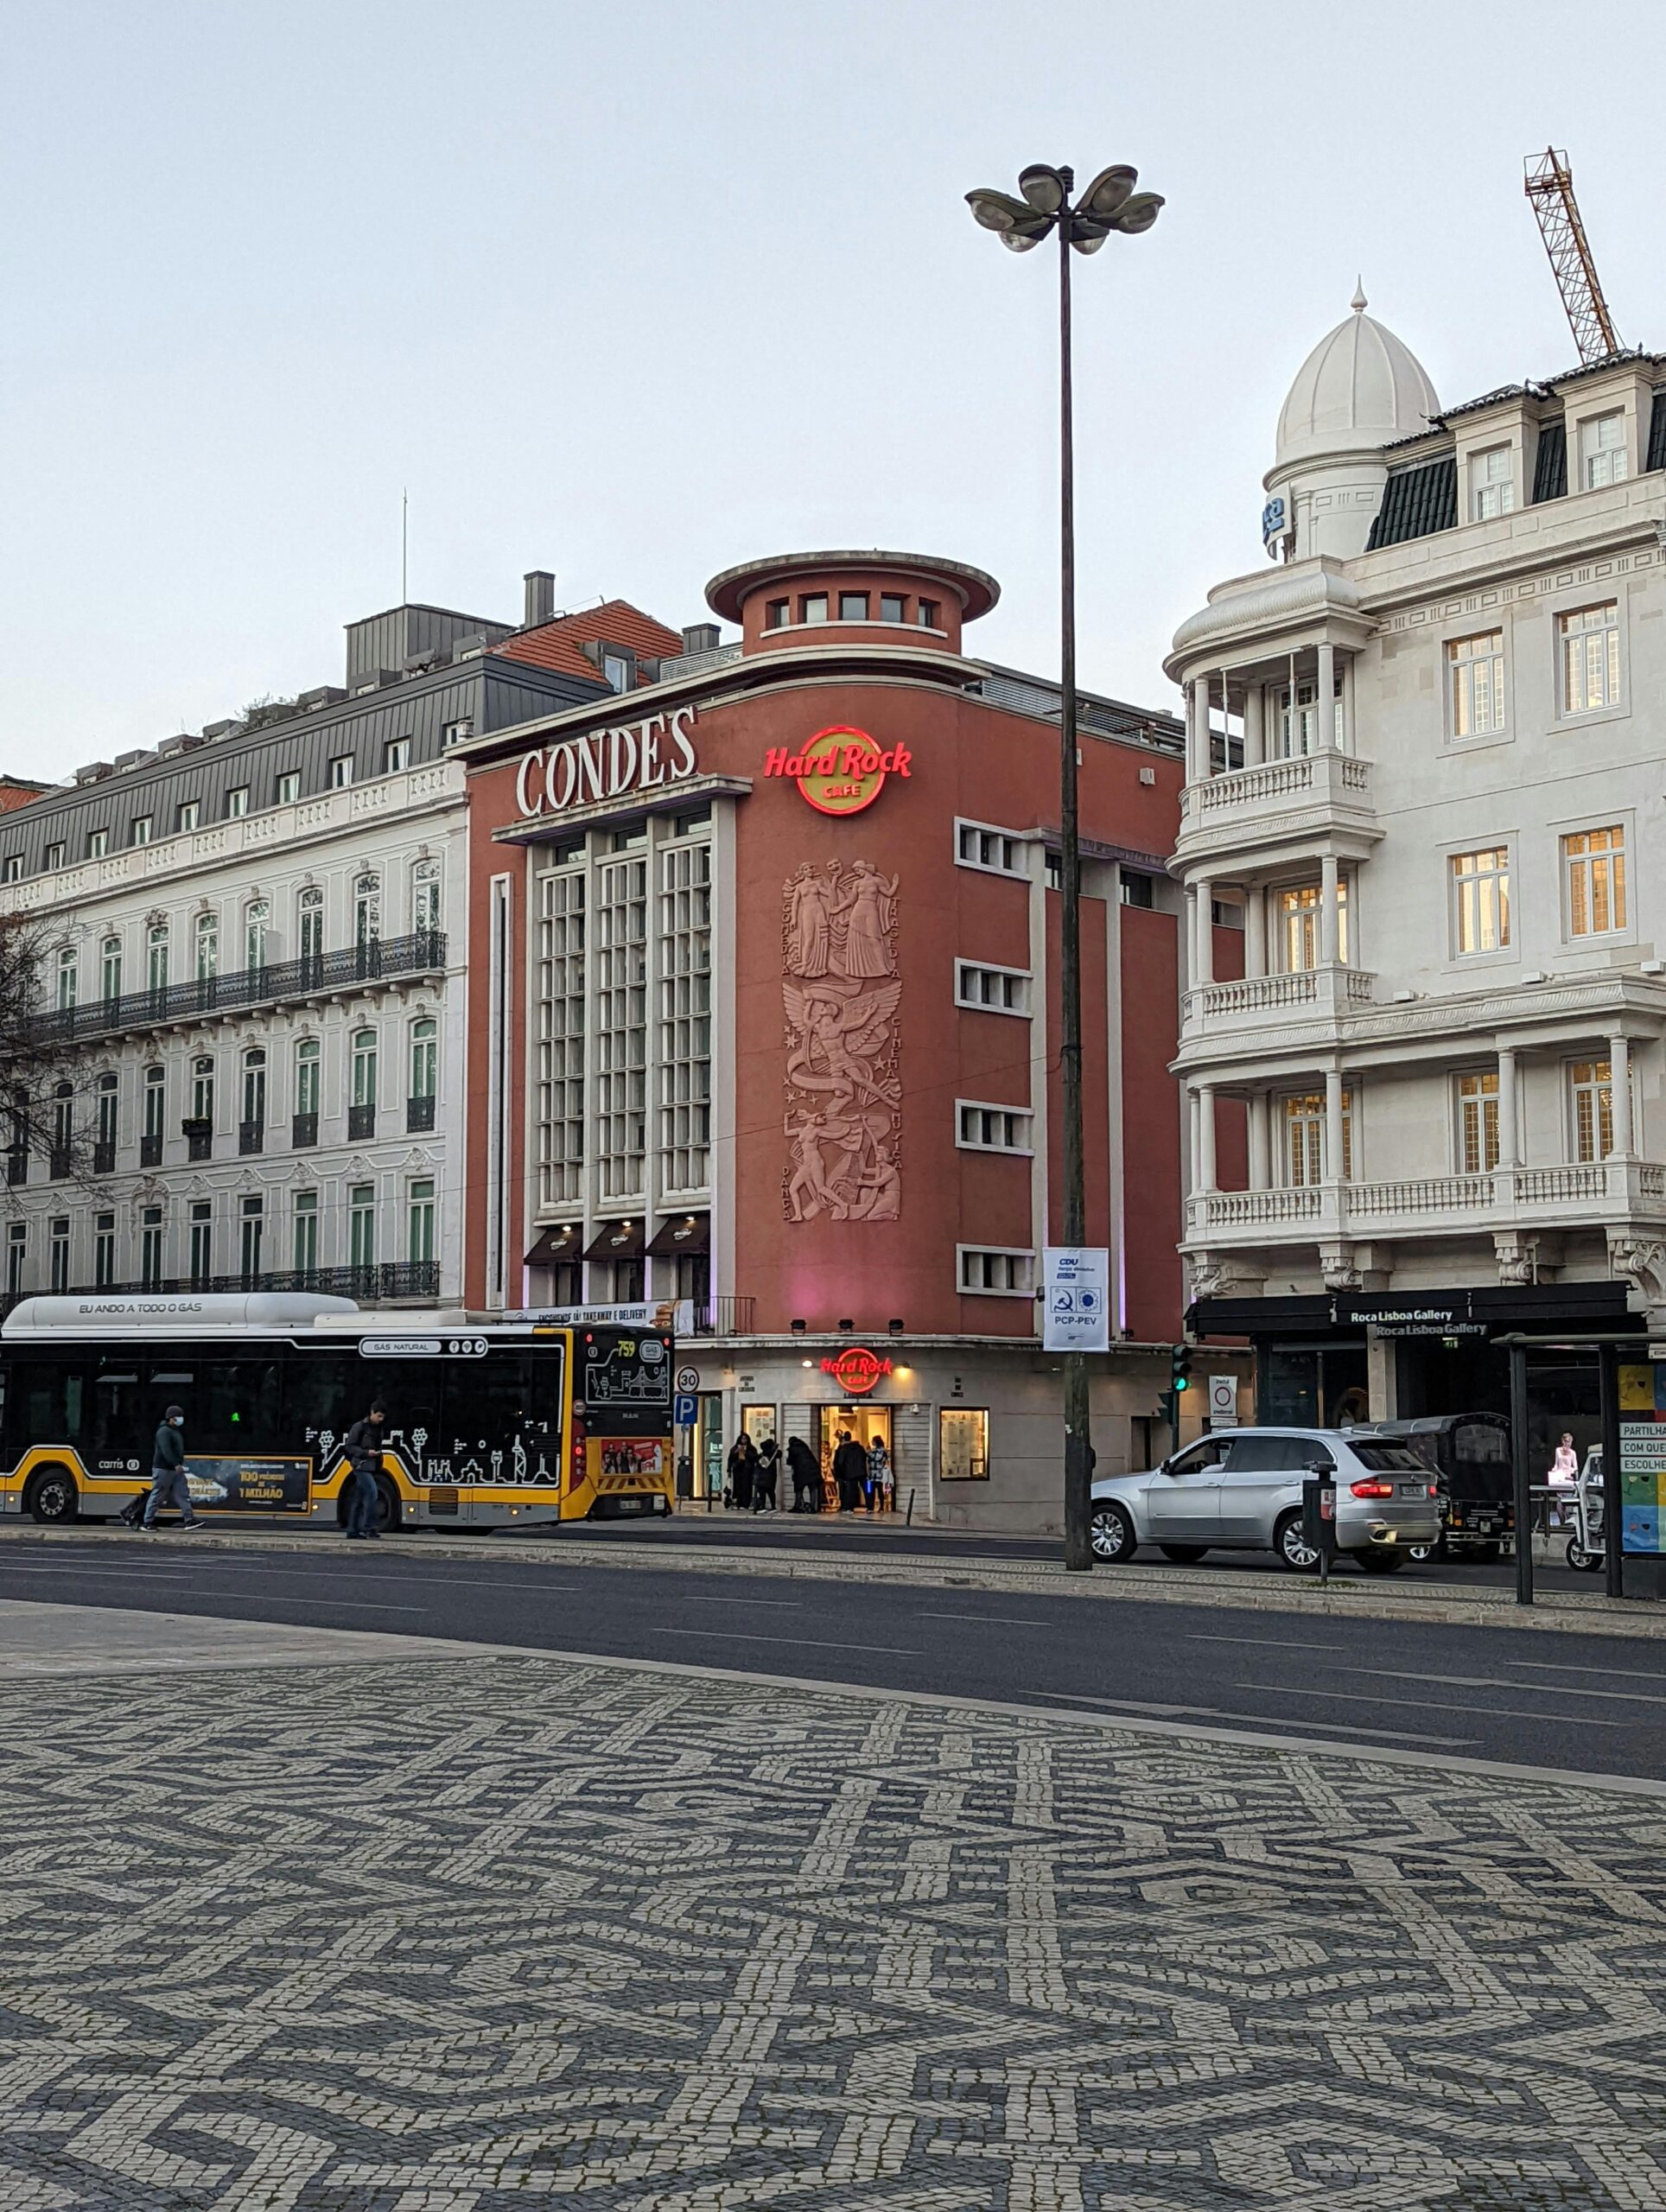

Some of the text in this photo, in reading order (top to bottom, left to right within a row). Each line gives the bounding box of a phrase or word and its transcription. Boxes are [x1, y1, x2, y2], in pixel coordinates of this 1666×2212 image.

[517, 706, 696, 817] CONDES
[764, 742, 912, 781] Hard Rock
[823, 785, 861, 799] CAFE
[79, 1305, 93, 1313] EU
[94, 1304, 125, 1313] ANDO
[126, 1304, 135, 1313] A
[137, 1303, 166, 1313] TODO
[168, 1303, 176, 1313] O
[583, 1311, 613, 1320] TAKEAWAY
[619, 1309, 646, 1319] DELIVERY
[1055, 1316, 1097, 1325] PCP-PEV
[1351, 1310, 1453, 1322] Roca Lisboa Gallery
[1377, 1324, 1487, 1336] Roca Lisboa Gallery
[618, 1340, 635, 1357] 759
[820, 1357, 893, 1376] Hard Rock
[681, 1375, 696, 1386] 30
[679, 1398, 694, 1421] P
[1624, 1443, 1644, 1452] COM
[99, 1458, 124, 1469] carris
[240, 1471, 259, 1481] 100
[245, 1485, 283, 1499] MILHÃO
